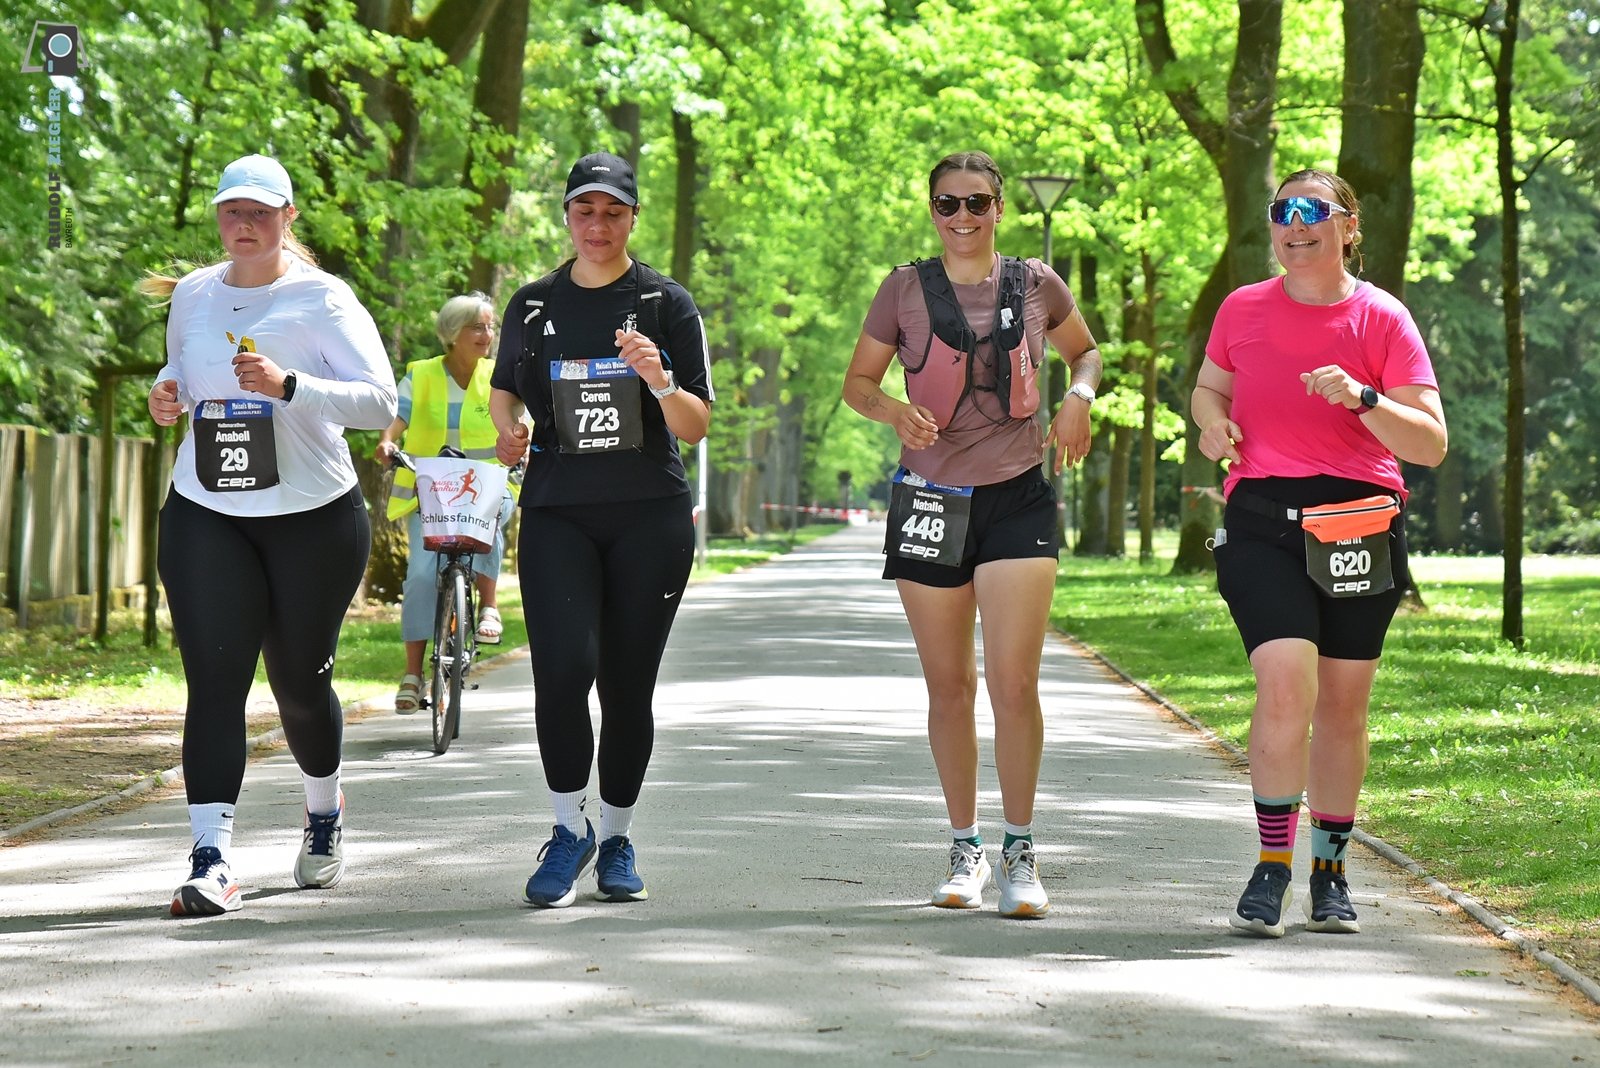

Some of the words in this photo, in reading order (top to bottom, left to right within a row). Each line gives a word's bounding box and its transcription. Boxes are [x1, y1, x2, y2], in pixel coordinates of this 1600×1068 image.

[581, 391, 611, 403] Ceren
[575, 407, 620, 433] 723
[215, 430, 251, 443] Anabell
[578, 437, 620, 449] cep
[220, 447, 249, 472] 29
[217, 477, 256, 489] cep
[912, 498, 944, 513] Natalie
[421, 512, 490, 530] Schlussfahrrad
[901, 514, 945, 543] 448
[899, 542, 940, 558] cep
[1329, 549, 1371, 577] 620
[1333, 580, 1371, 593] cep
